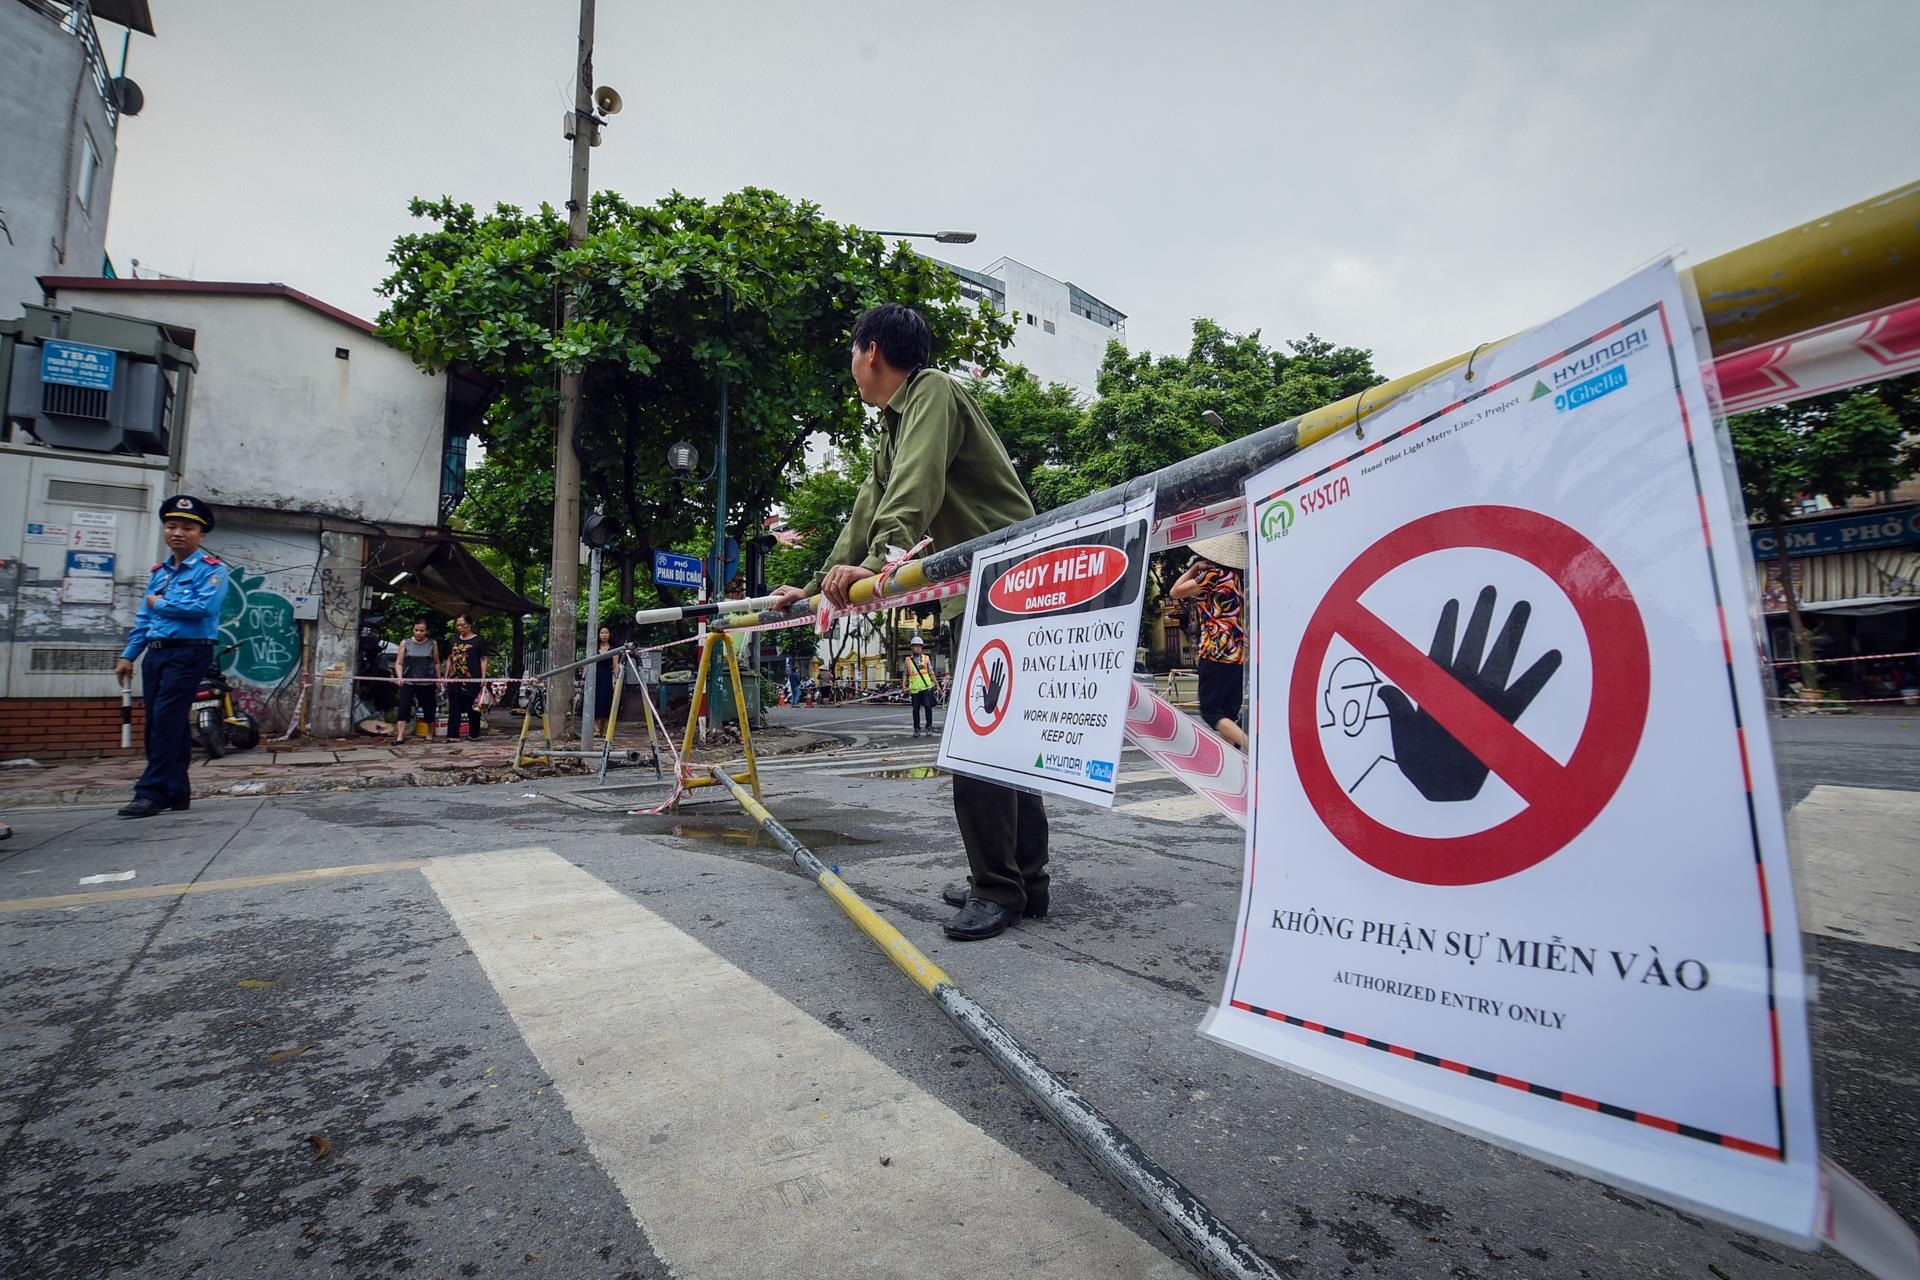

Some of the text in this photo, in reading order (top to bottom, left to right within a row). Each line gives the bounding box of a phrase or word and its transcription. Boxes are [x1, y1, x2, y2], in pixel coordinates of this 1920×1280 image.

[59, 350, 99, 363] TBA
[1553, 328, 1648, 384] HYUNDAI
[1570, 373, 1624, 404] Ghella
[1360, 397, 1520, 476] Hanoi Pilot Light Metro Line 3 Project
[1300, 476, 1351, 516] SYSTRA
[1266, 529, 1289, 544] MRB
[657, 567, 702, 583] PHAN BỘI CHÂU
[673, 560, 689, 568] PHỐ
[1003, 550, 1106, 594] NGUY HIỂM
[1025, 591, 1067, 610] DANGER
[1028, 619, 1125, 647] CÔNG TRƯỜNG
[1022, 649, 1125, 675] ĐANG LÀM VIỆC
[1071, 676, 1098, 700] VÀO
[1023, 709, 1108, 727] WORK IN PROGRESS
[1041, 729, 1084, 745] KEEP OUT
[1046, 753, 1083, 771] HYUNDAI
[1271, 907, 1710, 992] KHÔNG PHẬN SỰ MIỄN VÀO
[1333, 970, 1567, 1030] AUTHORIZED ENTRY ONLY
